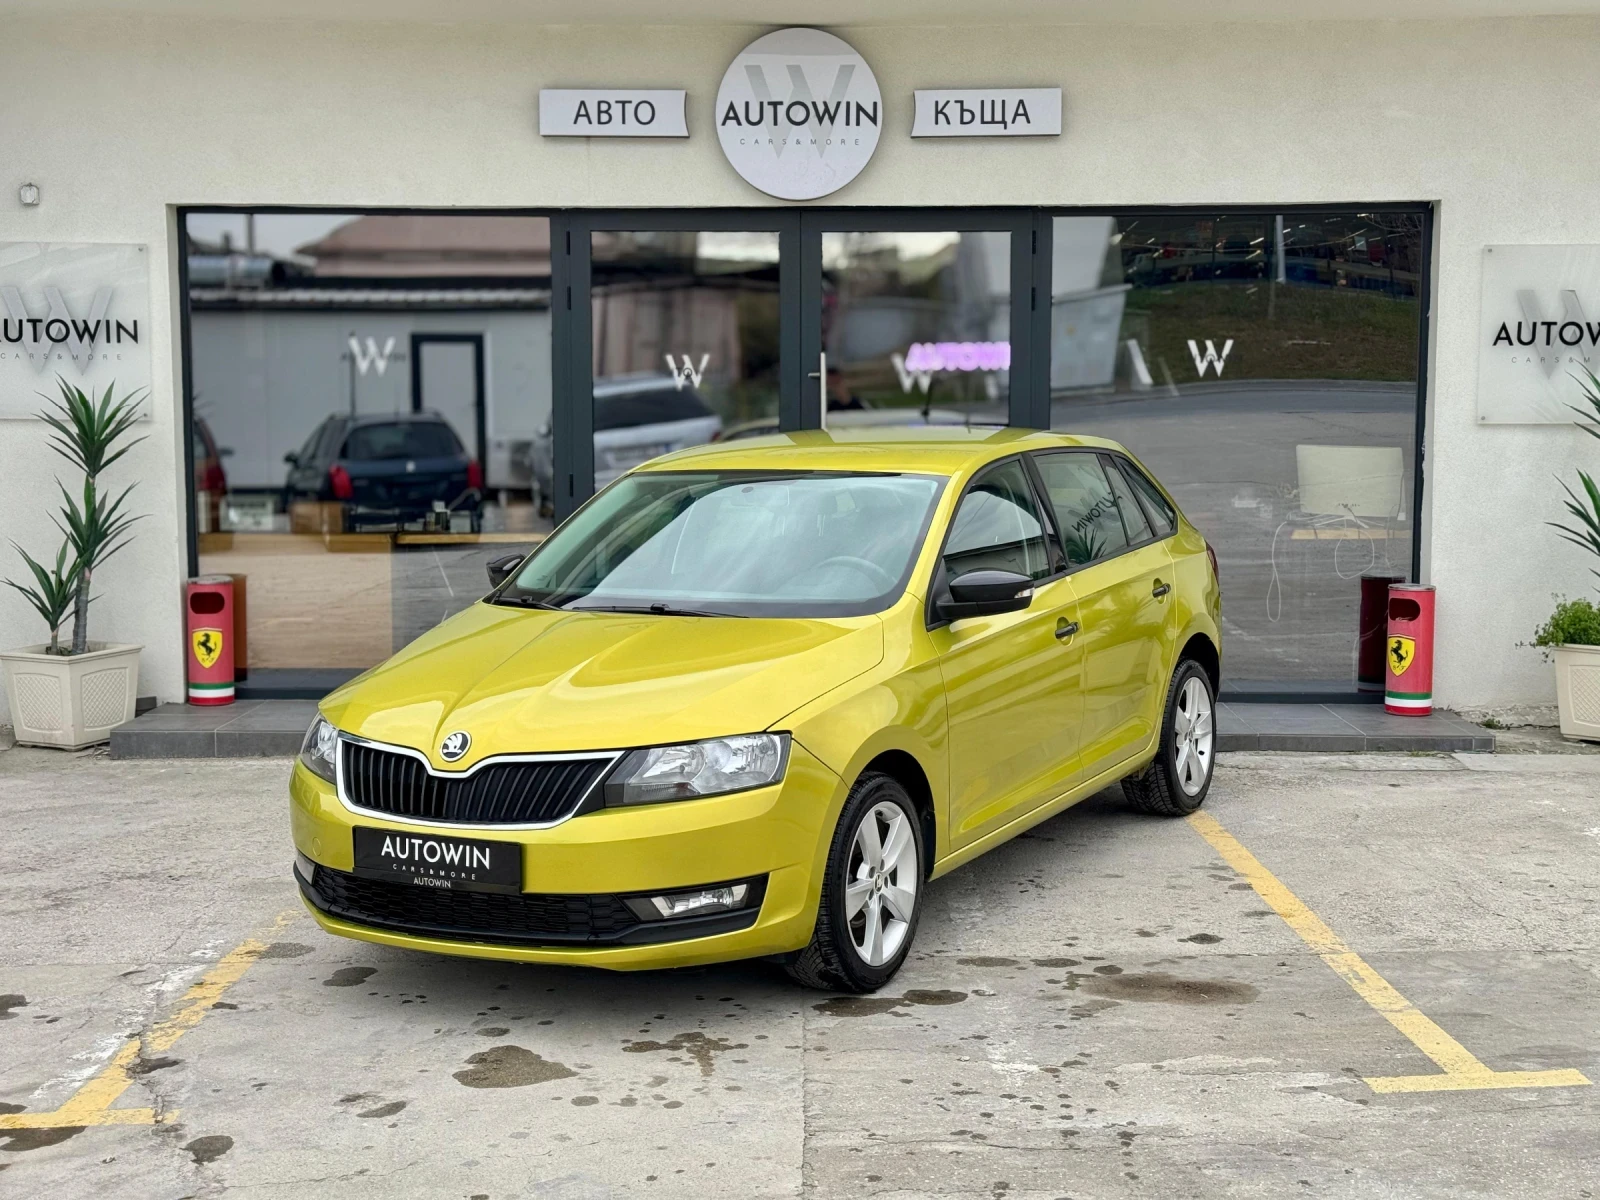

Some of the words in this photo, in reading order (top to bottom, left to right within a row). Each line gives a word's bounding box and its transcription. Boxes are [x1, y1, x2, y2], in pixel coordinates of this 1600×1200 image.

[573, 99, 656, 126] АВТО
[720, 99, 879, 128] AUTOWIN
[934, 99, 1031, 130] КЪЩА
[0, 317, 139, 345] UTOWIN
[348, 336, 396, 377] W
[1187, 339, 1234, 378] W
[665, 354, 710, 392] W
[380, 835, 490, 871] AUTOWIN
[413, 876, 452, 889] AUTOWIN
